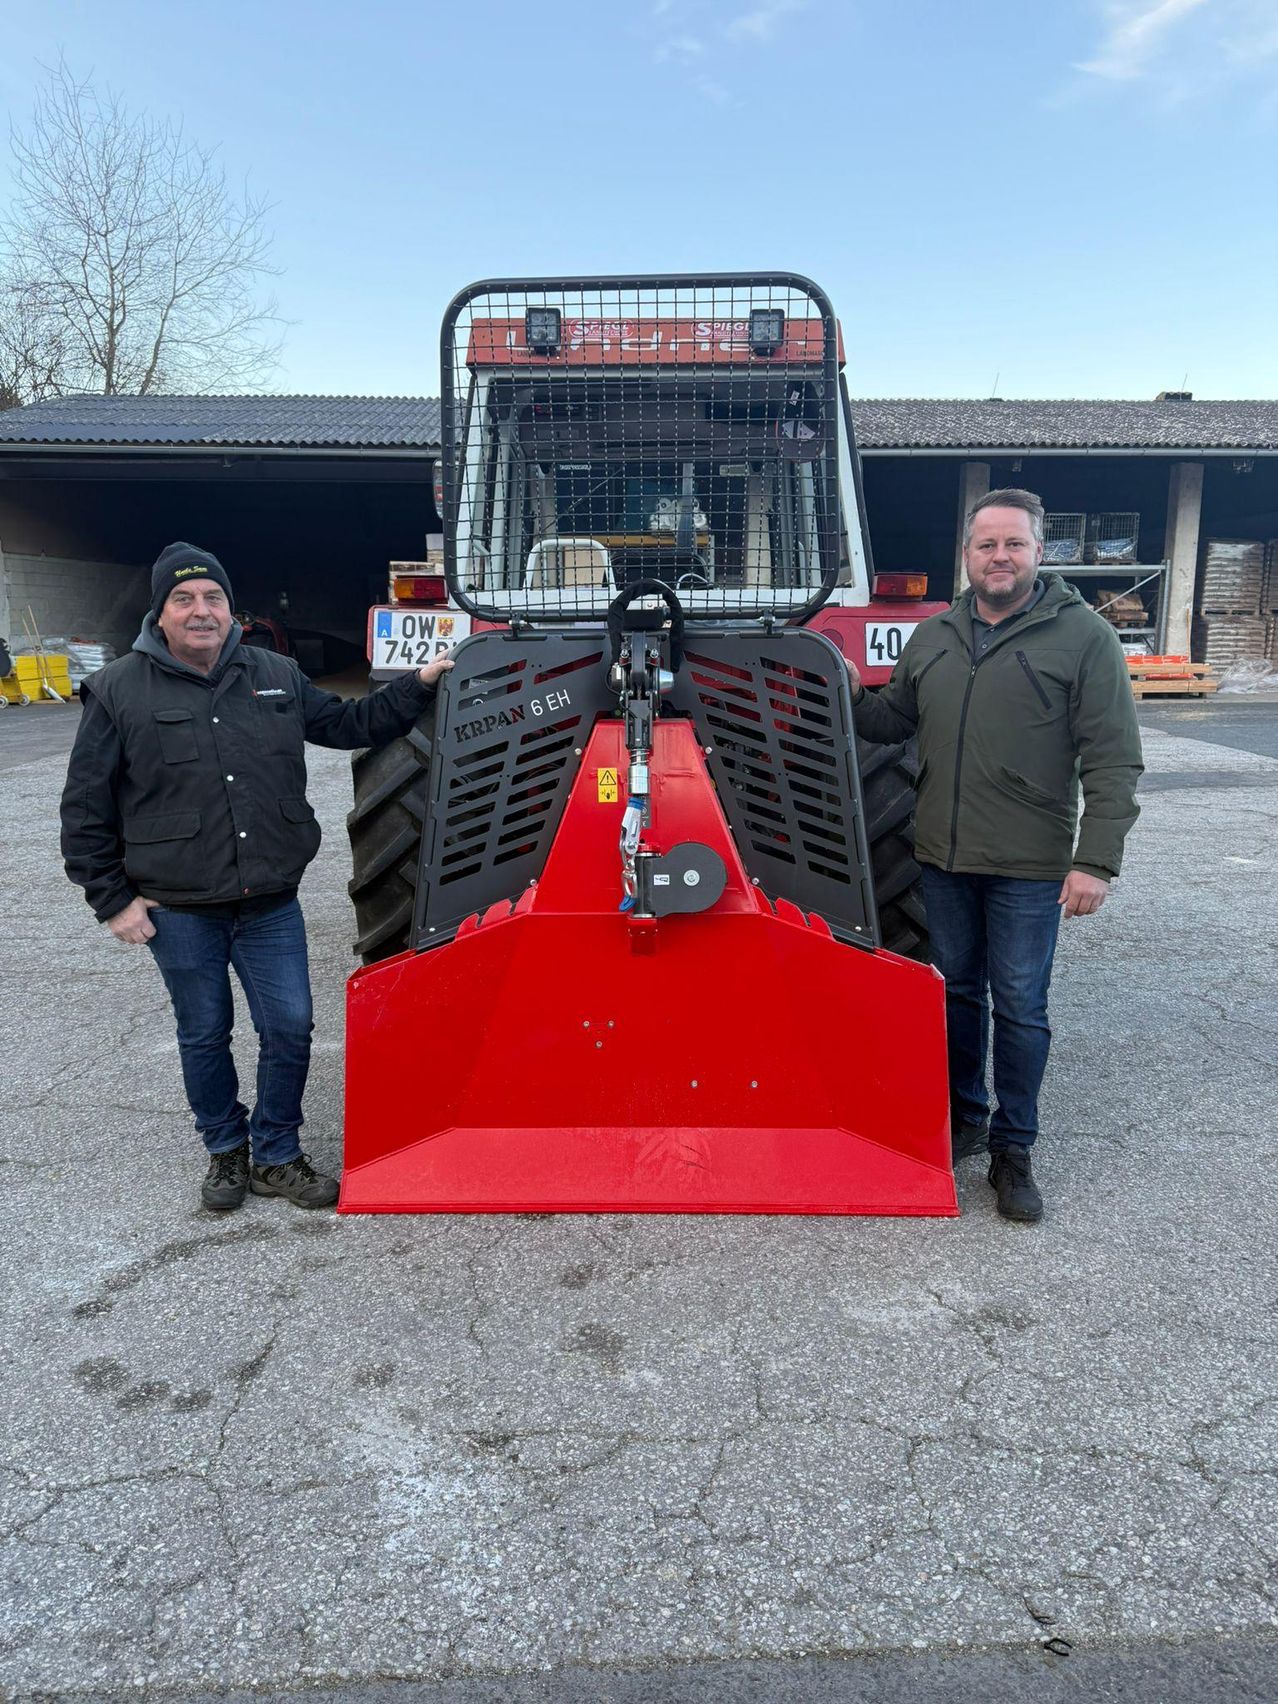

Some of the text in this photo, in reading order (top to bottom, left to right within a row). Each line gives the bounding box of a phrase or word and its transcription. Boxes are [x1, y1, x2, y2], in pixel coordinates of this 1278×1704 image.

[573, 321, 629, 336] SPIEGL
[695, 322, 751, 336] SPIEGL
[381, 628, 389, 637] A
[402, 615, 435, 639] OW
[869, 627, 902, 661] 40
[453, 689, 571, 743] KRPAN 6 EH
